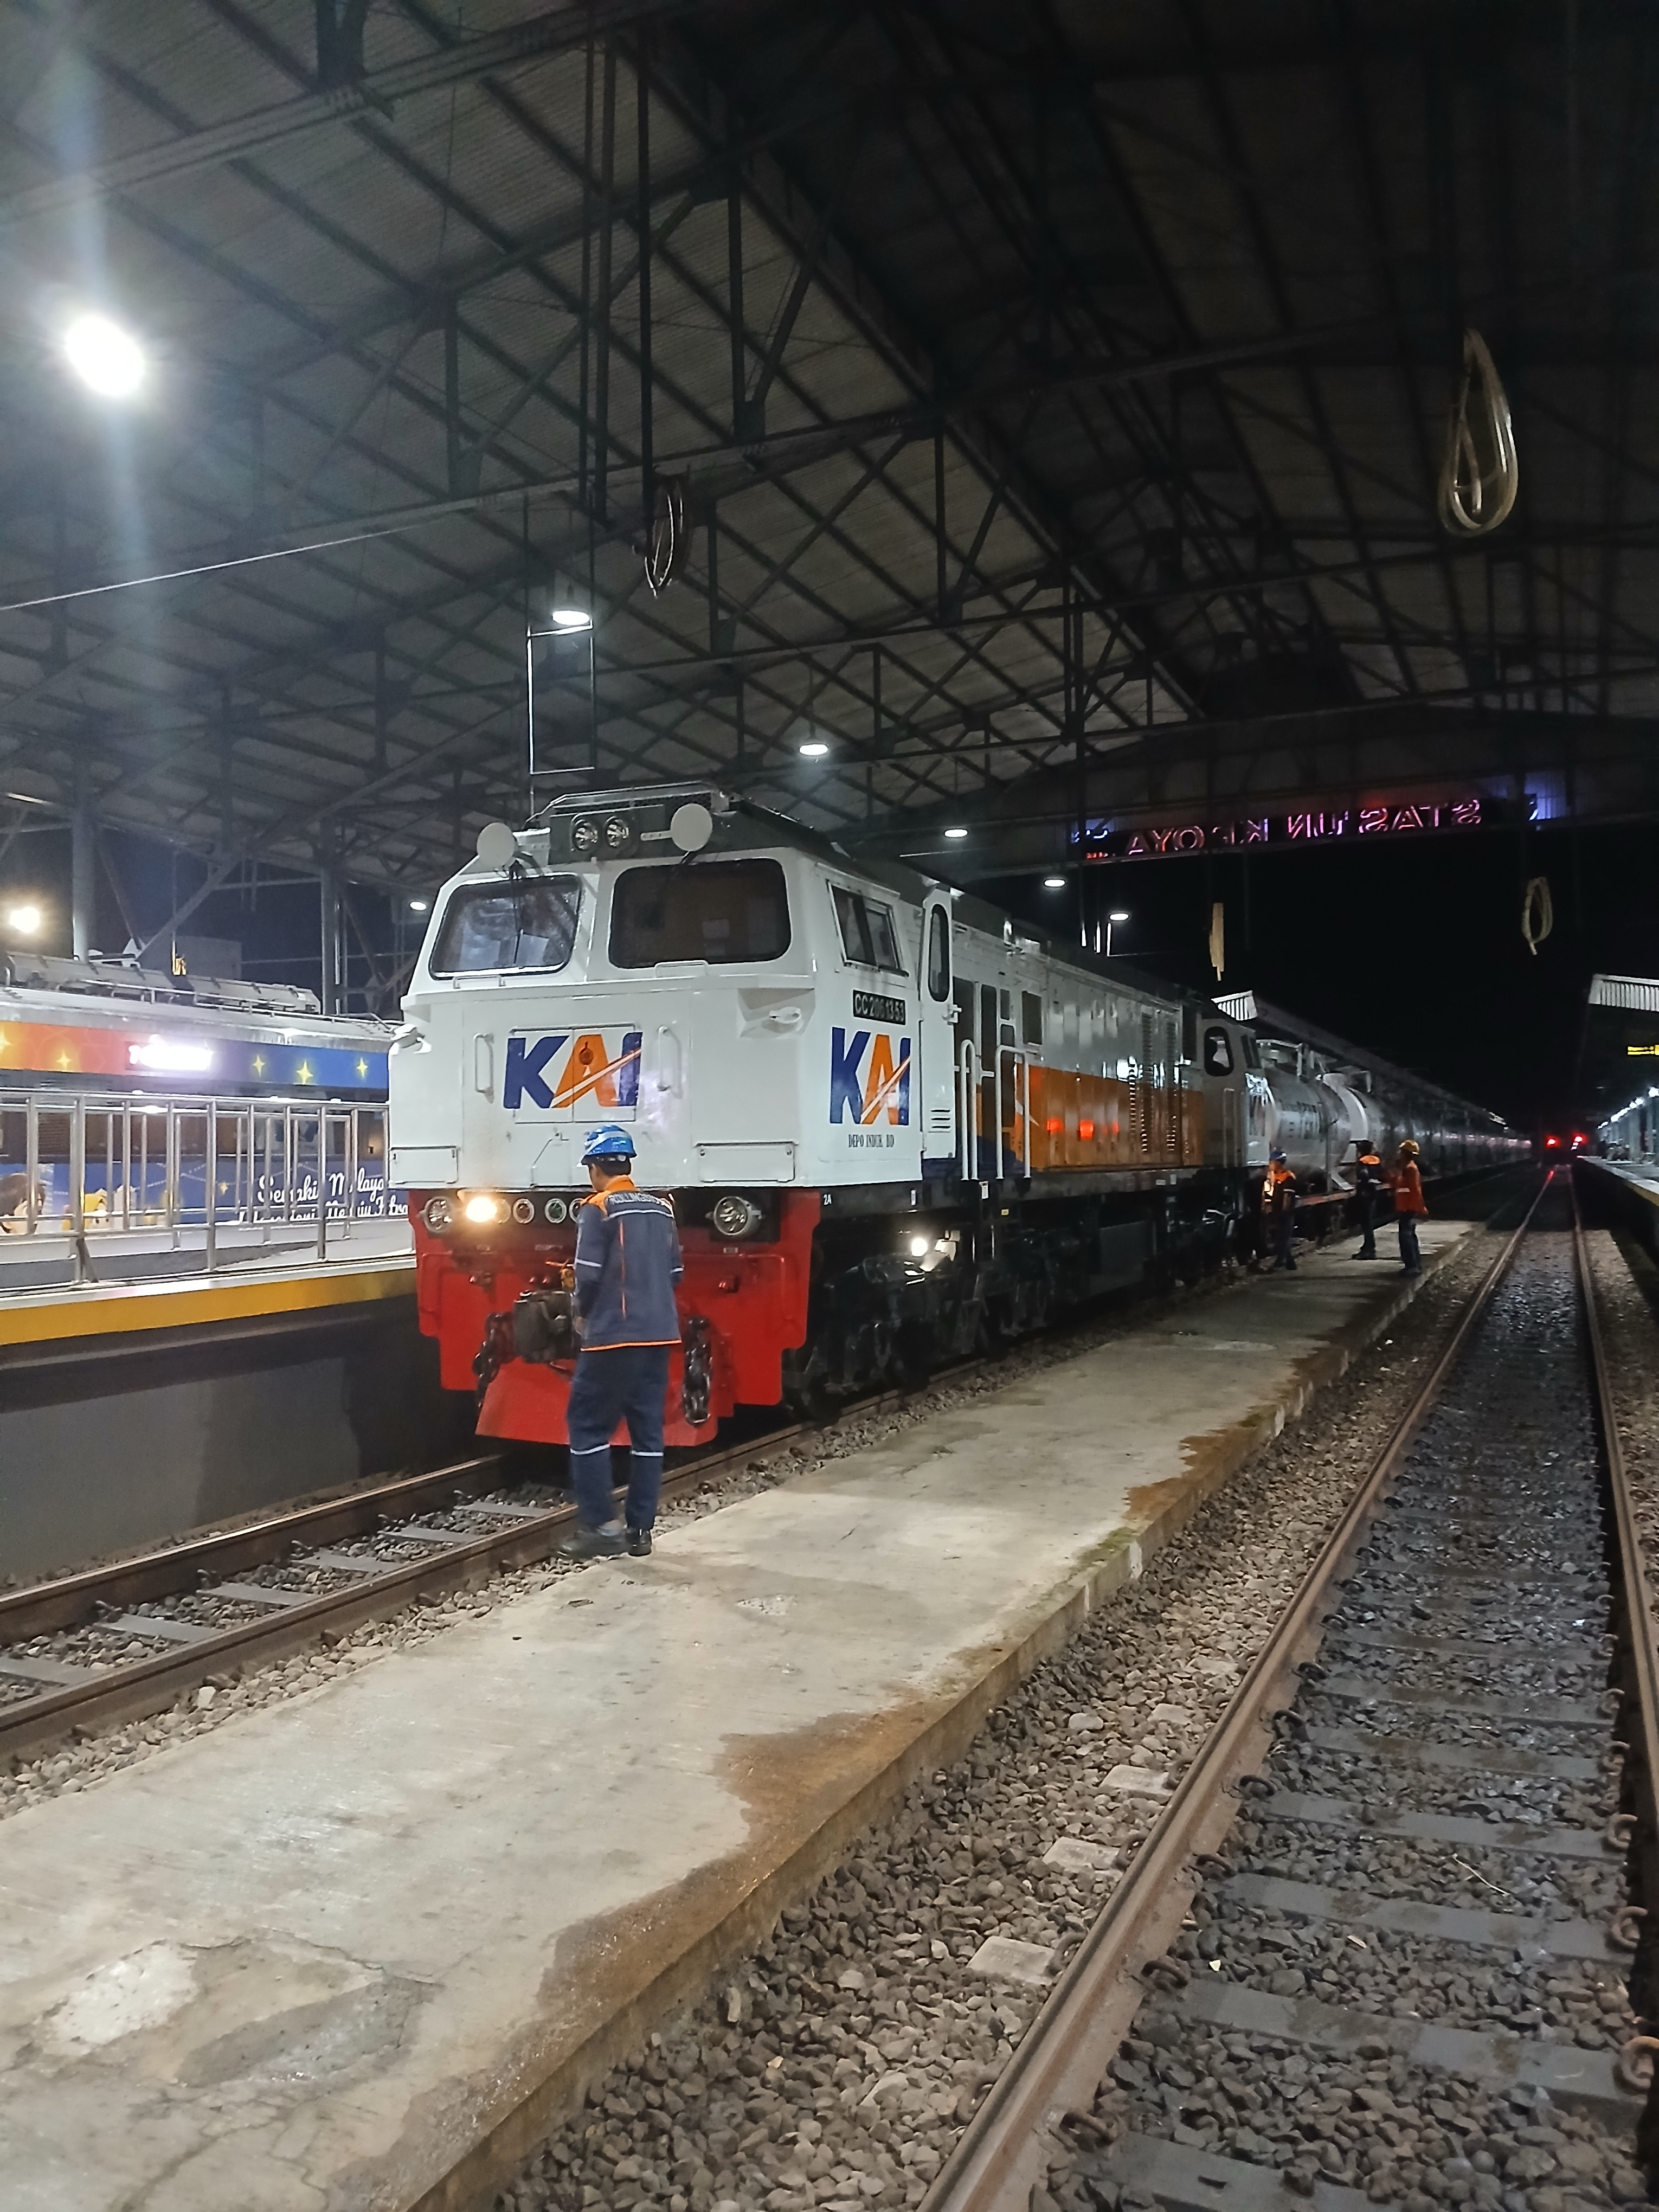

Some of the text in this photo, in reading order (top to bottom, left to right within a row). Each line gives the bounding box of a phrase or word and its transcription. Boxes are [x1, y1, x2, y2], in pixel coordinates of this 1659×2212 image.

[504, 1032, 643, 1109] KAI
[829, 1027, 911, 1126] KAI
[848, 1134, 864, 1148] DEPO
[824, 1194, 832, 1205] 2A
